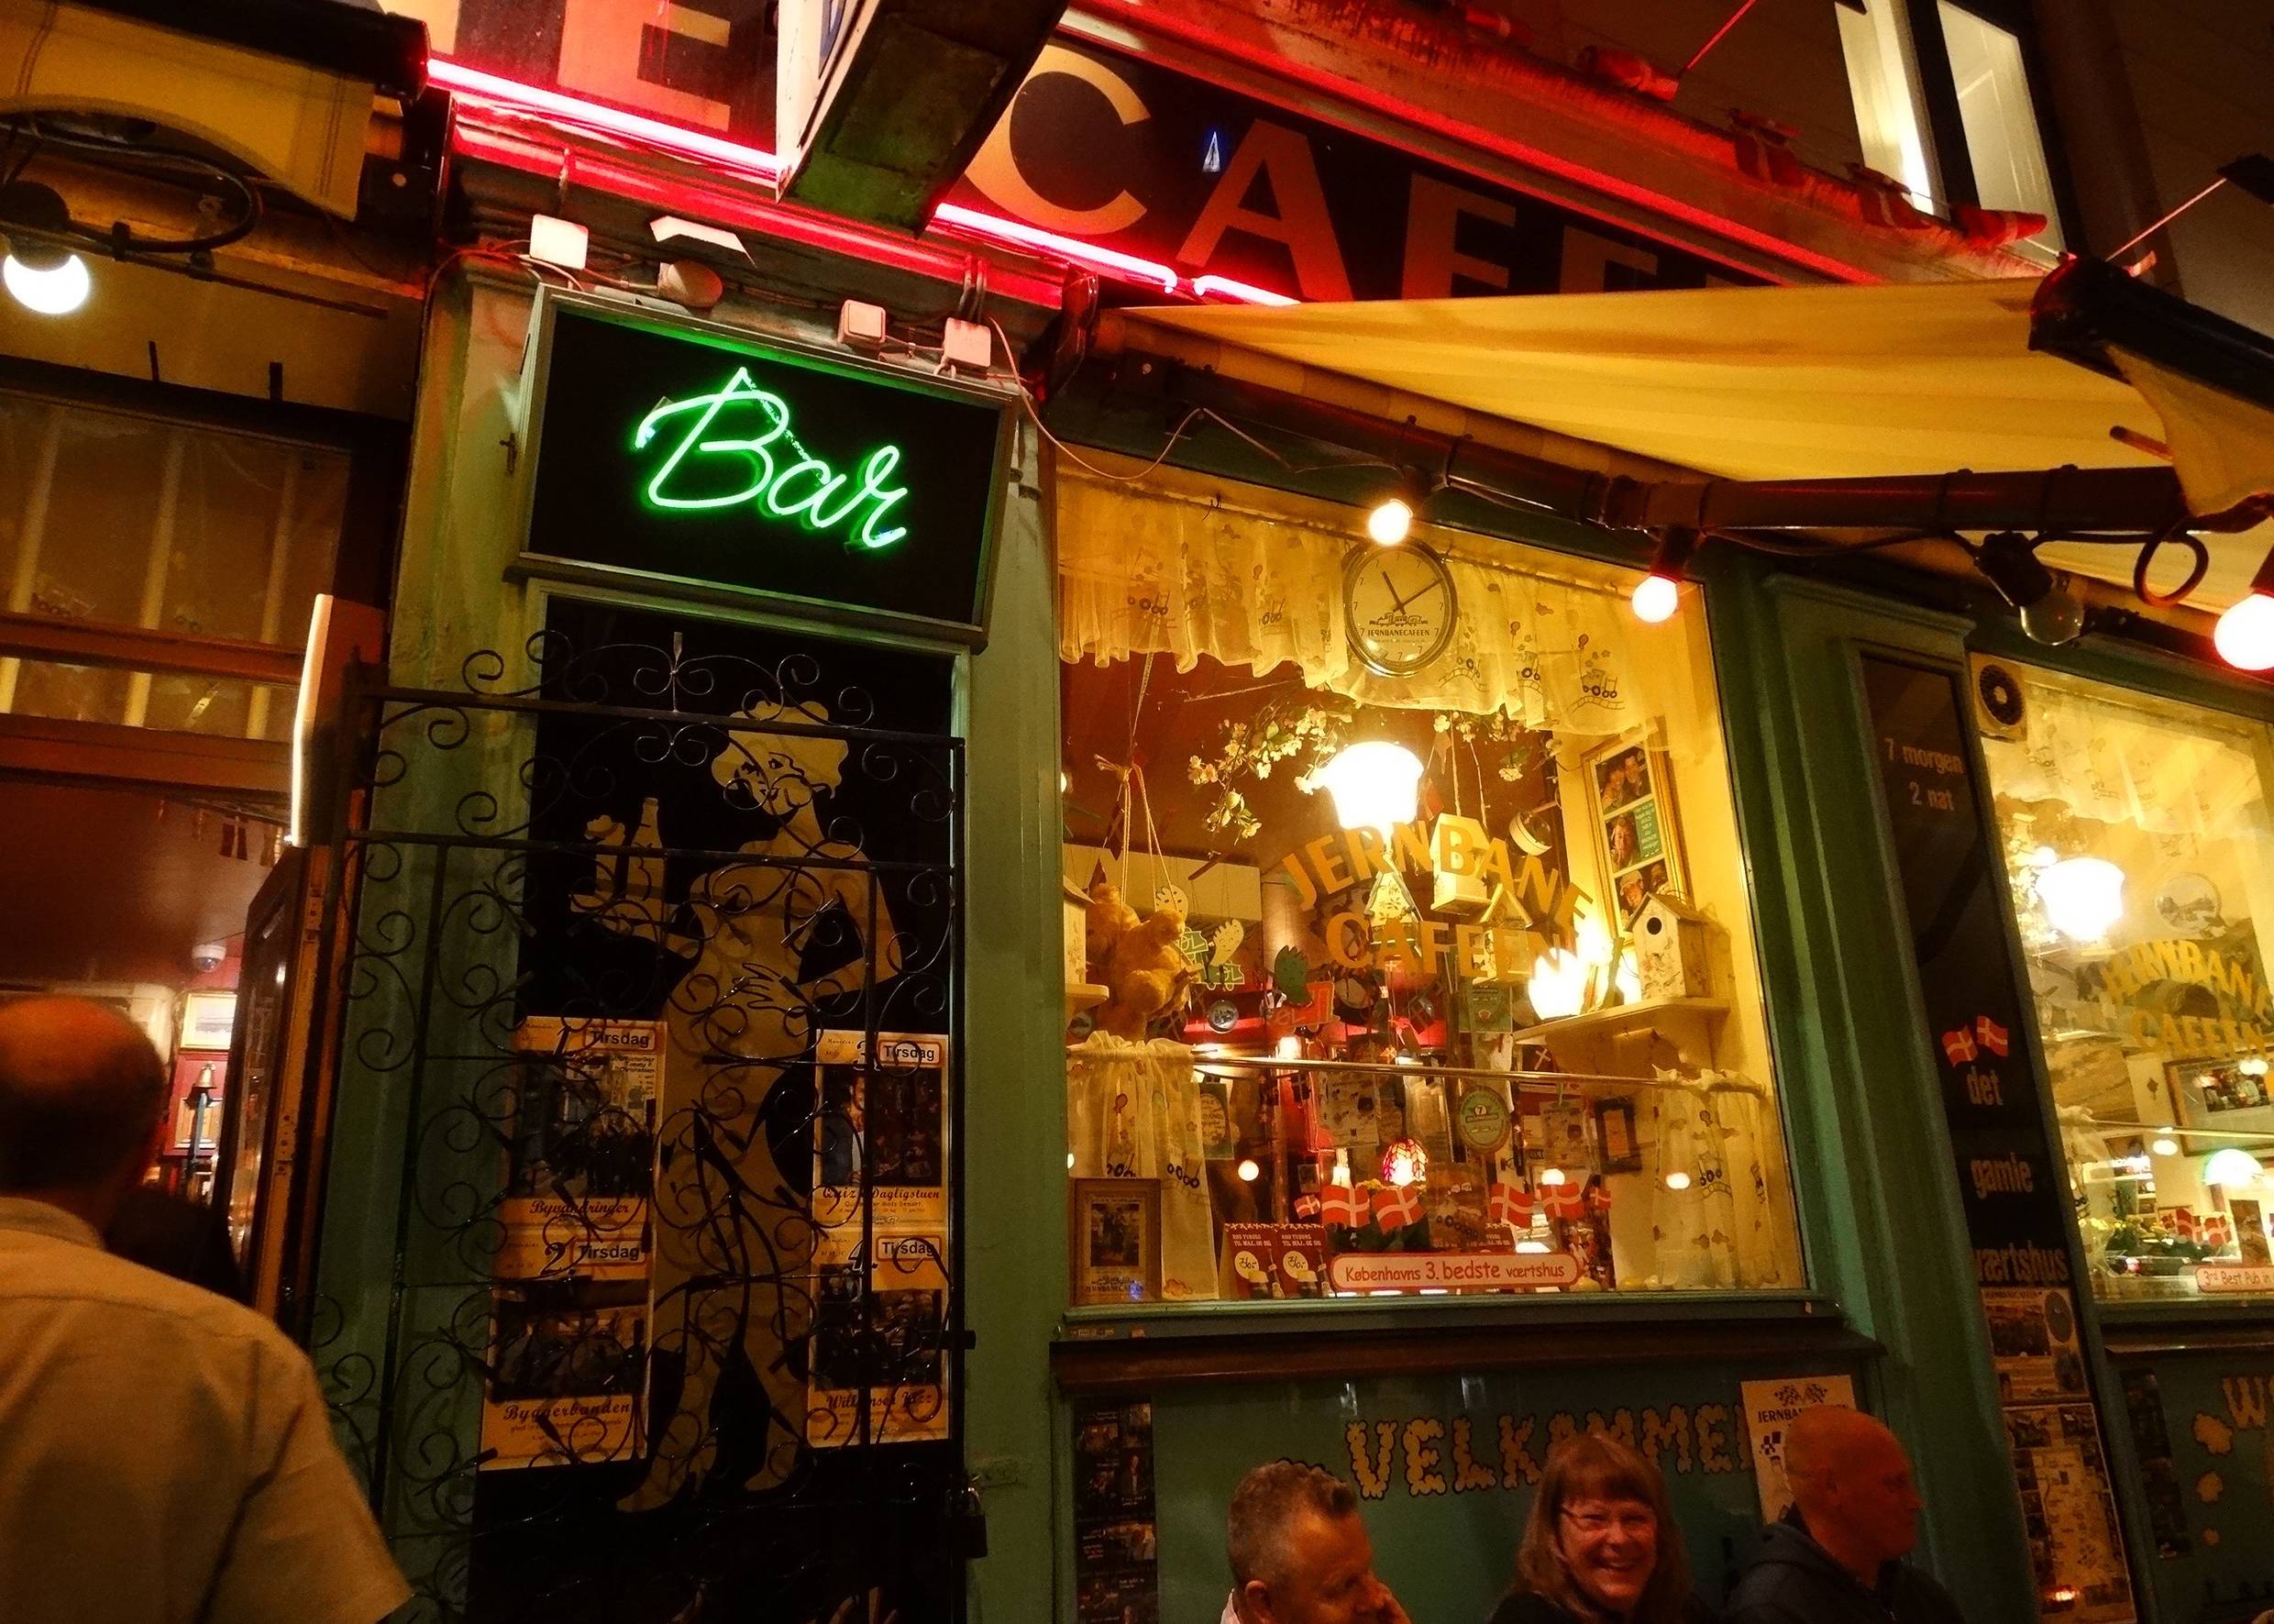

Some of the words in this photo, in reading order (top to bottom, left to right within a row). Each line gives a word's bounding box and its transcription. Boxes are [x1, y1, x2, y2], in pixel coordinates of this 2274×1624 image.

[635, 368, 907, 548] Bar
[1884, 737, 1894, 762] 7
[1902, 746, 1964, 775] morgen
[1908, 781, 1923, 805] 2
[1927, 790, 1955, 812] nat
[1282, 821, 1594, 939] JERNBANE
[591, 1031, 650, 1048] Tirsdag
[1967, 1065, 2004, 1106] det
[578, 1245, 640, 1261] Tirsdag
[1345, 1266, 1420, 1281] Københavns
[1426, 1262, 1439, 1279] 3.
[1443, 1259, 1500, 1279] bedste
[1507, 1262, 1564, 1277] værtshus
[2223, 1375, 2274, 1430] W
